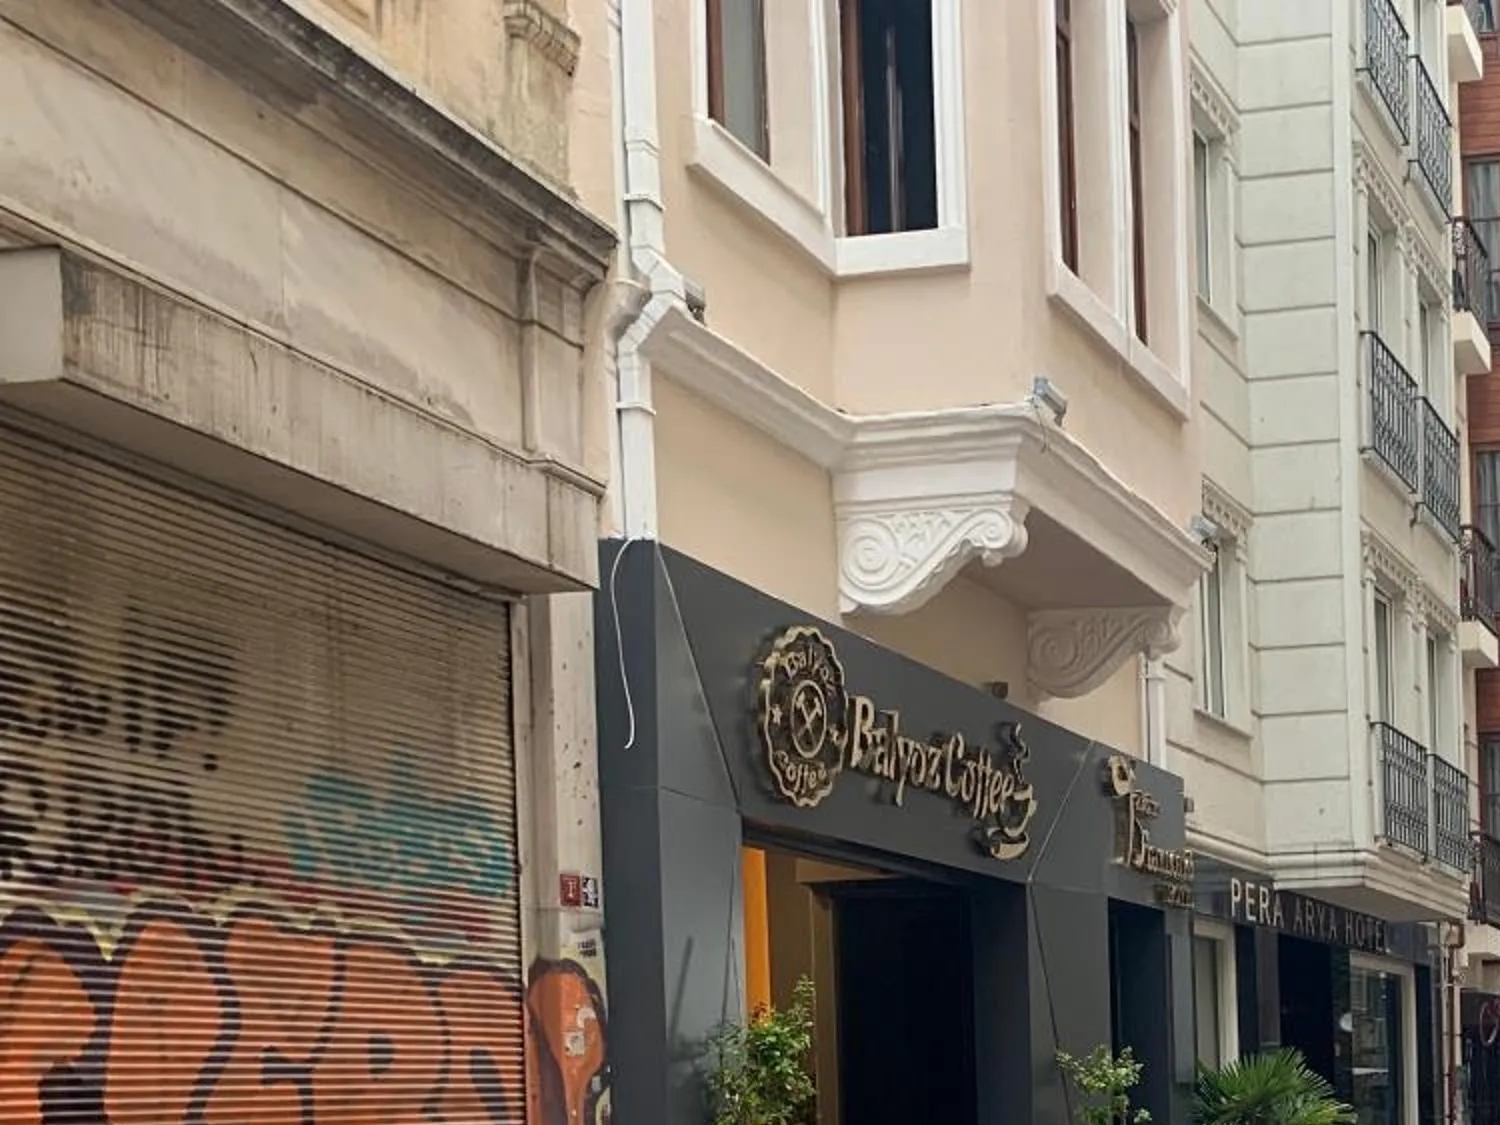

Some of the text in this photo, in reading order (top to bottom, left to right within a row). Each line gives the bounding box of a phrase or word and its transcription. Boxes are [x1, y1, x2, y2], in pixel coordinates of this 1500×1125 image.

[851, 696, 1014, 818] Balyoz Coffee
[1231, 877, 1284, 929] PERA
[1293, 897, 1338, 941] ARYA
[1345, 911, 1392, 954] HOTEL
